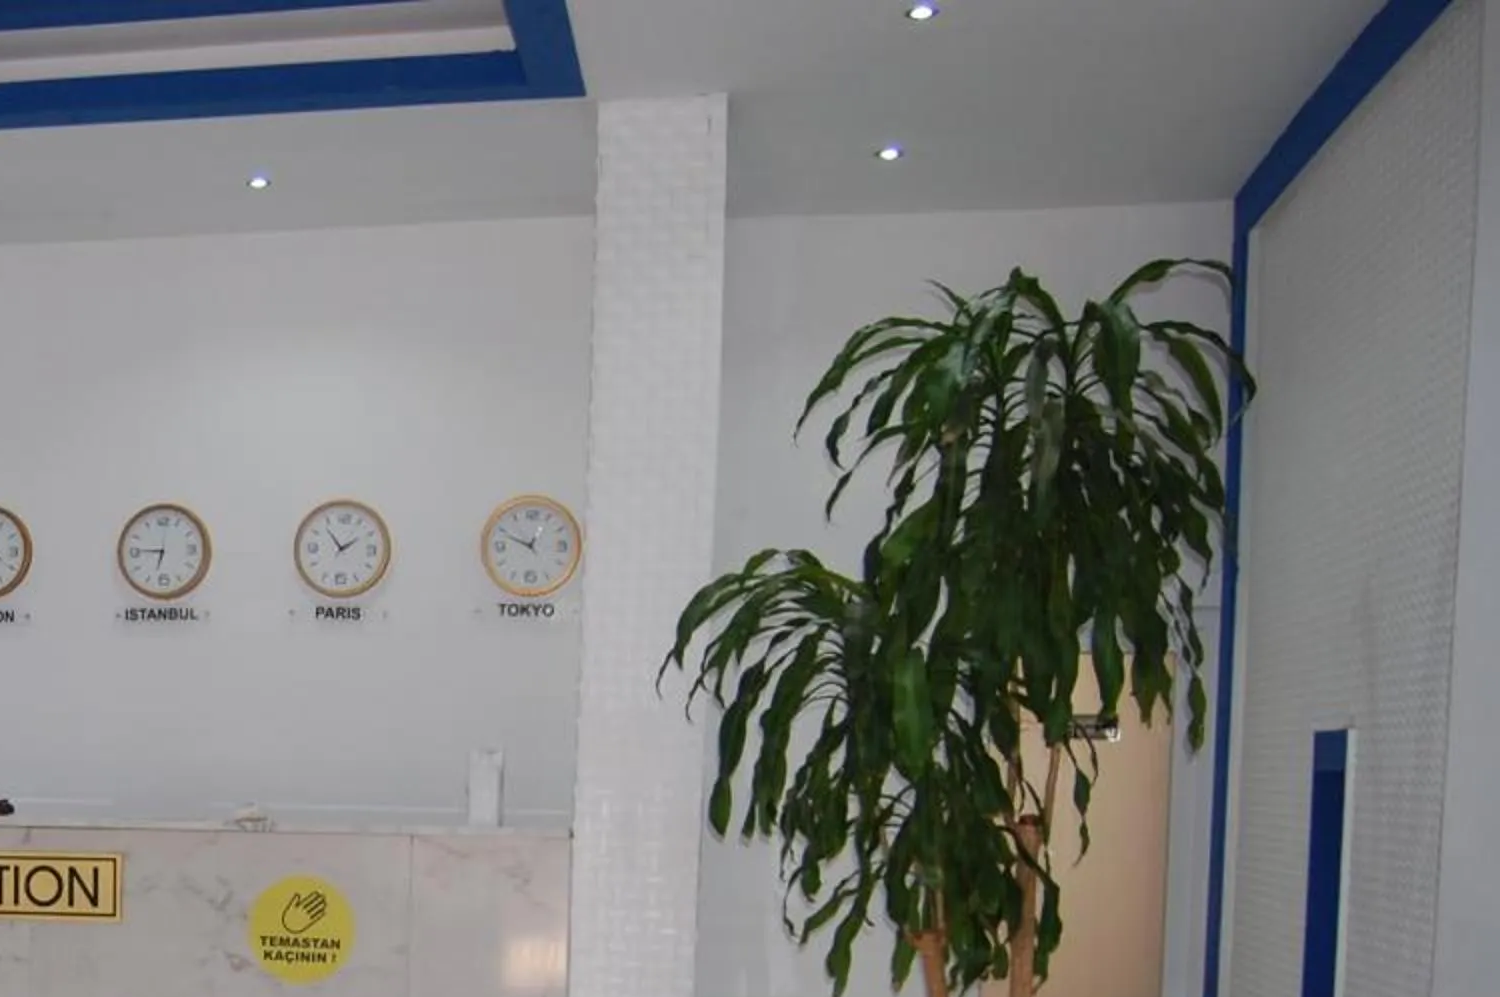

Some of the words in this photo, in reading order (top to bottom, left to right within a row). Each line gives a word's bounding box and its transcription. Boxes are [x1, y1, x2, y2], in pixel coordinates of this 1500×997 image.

[125, 607, 199, 621] ISTANBUL
[315, 605, 361, 620] PARIS
[499, 603, 555, 617] TOKYO
[260, 935, 340, 949] TEMASTAN
[263, 949, 327, 964] KAÇININ
